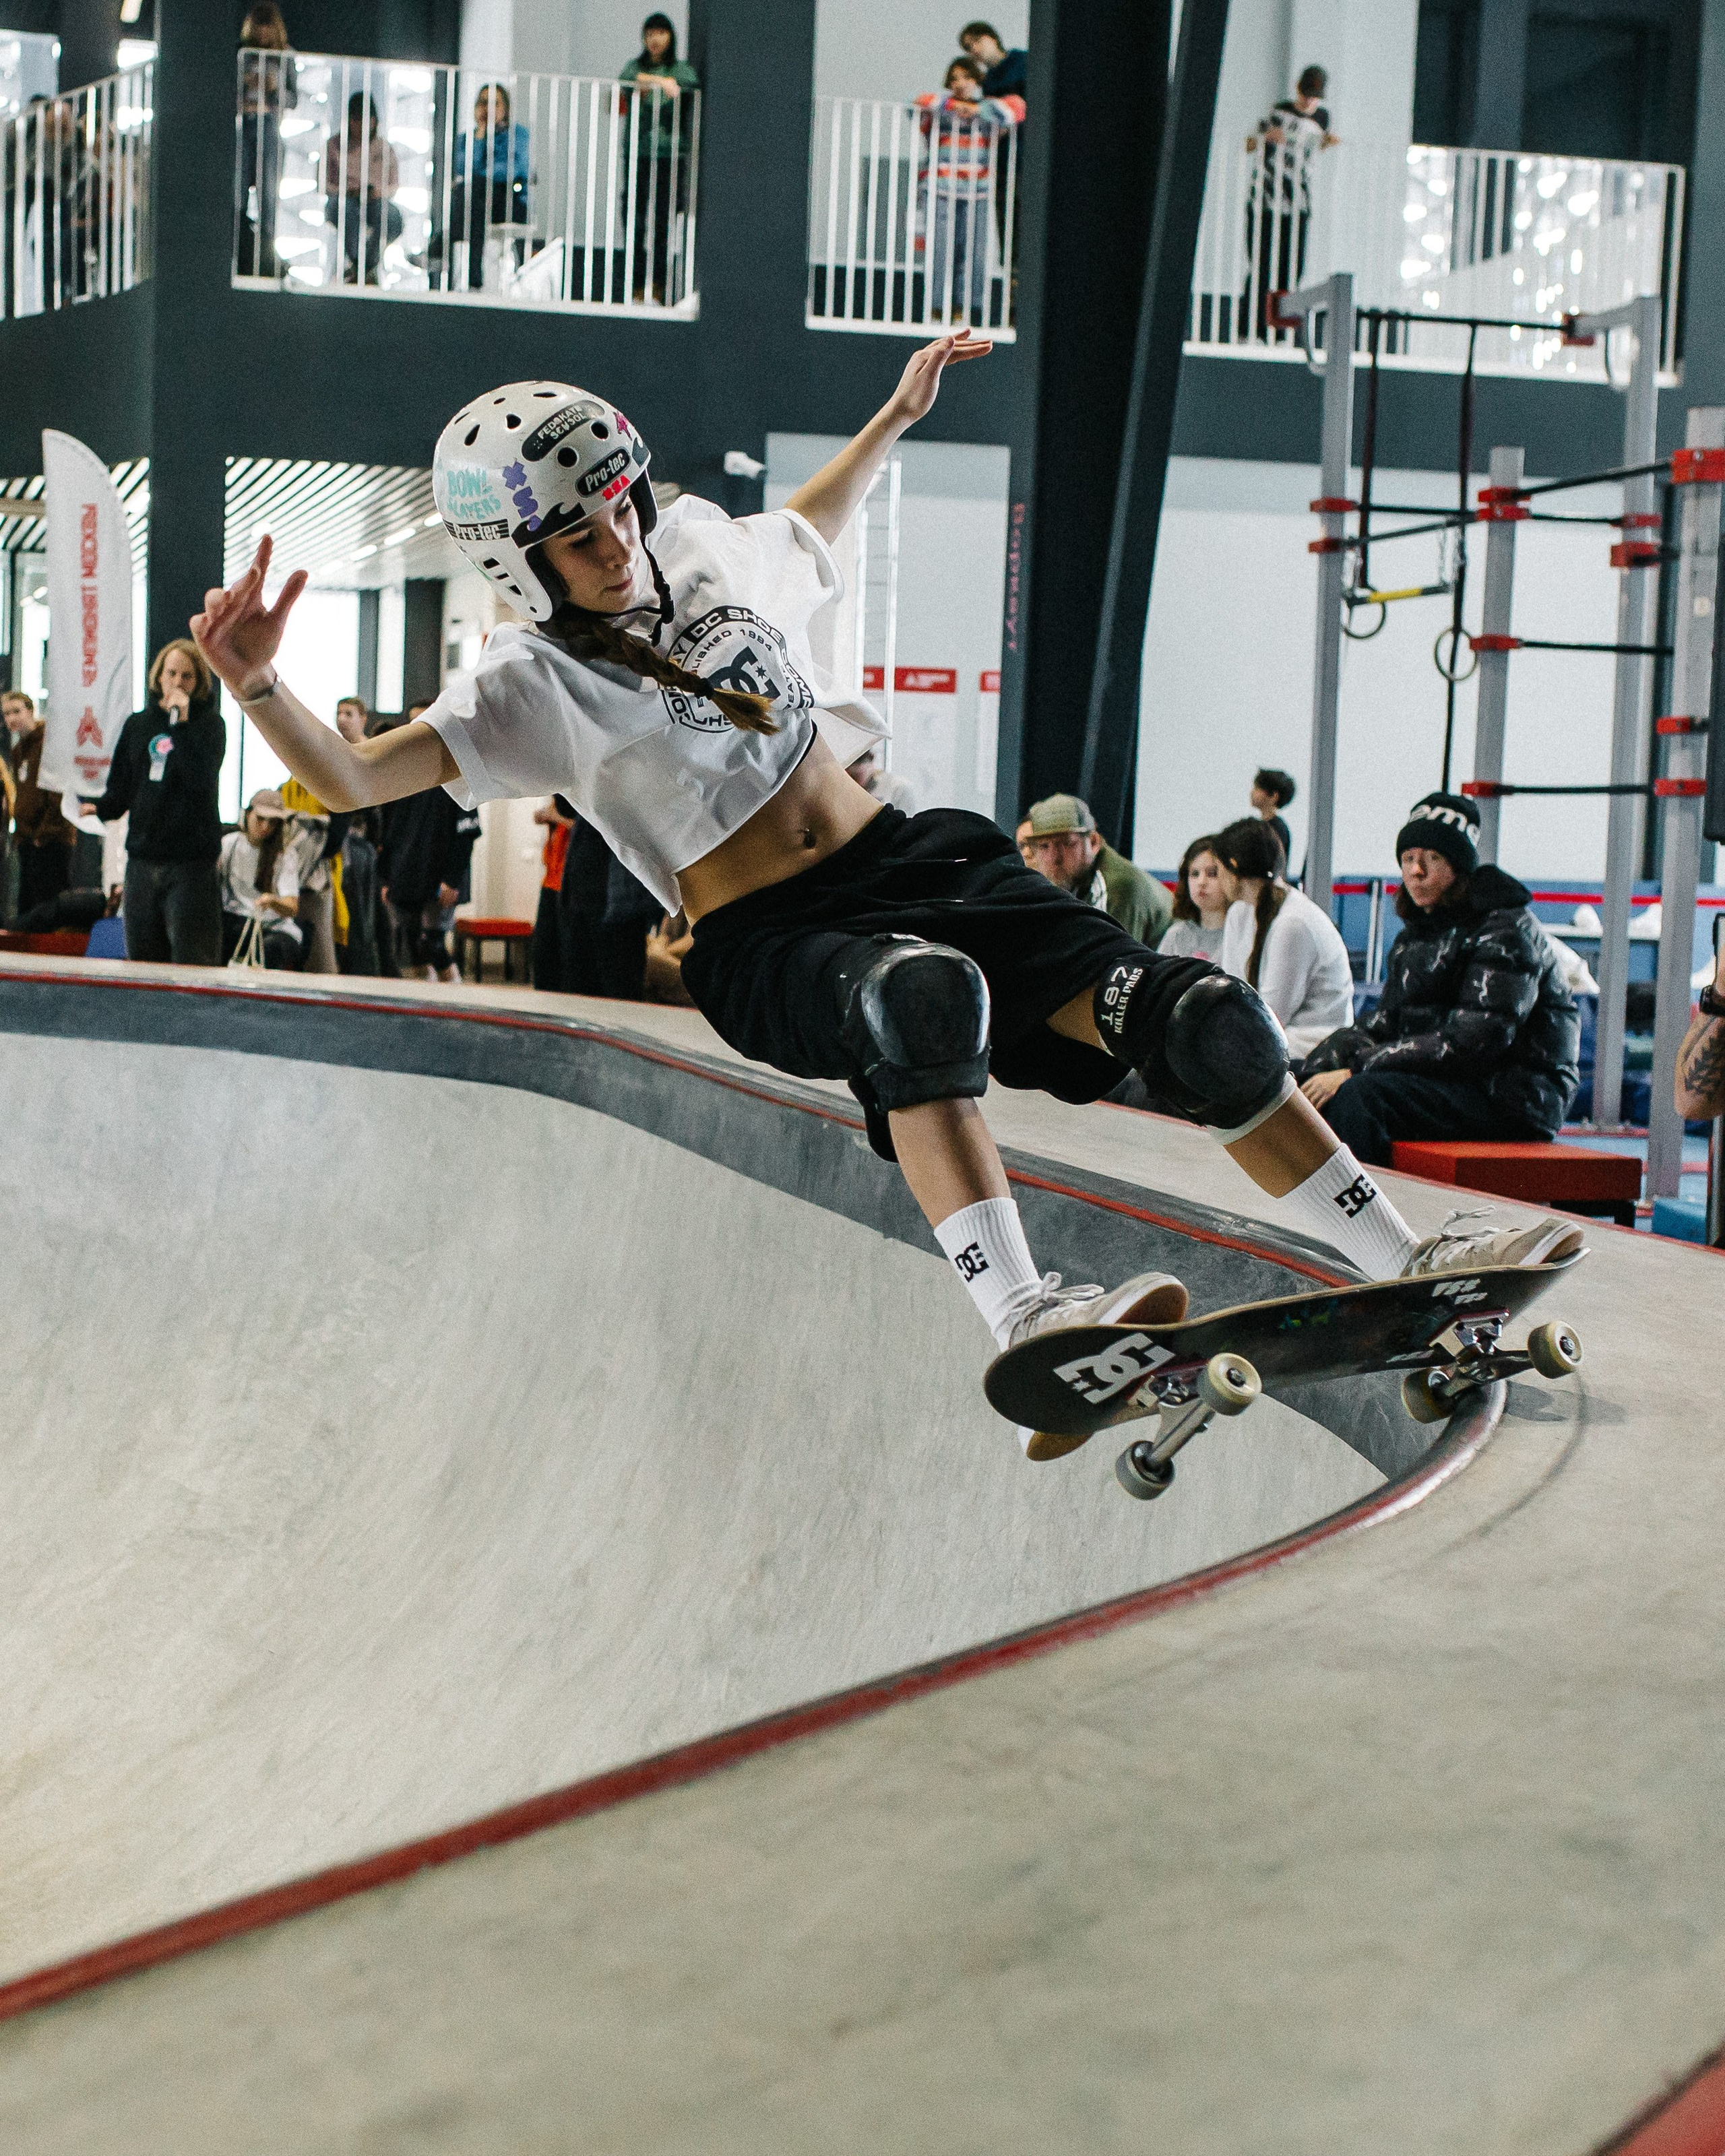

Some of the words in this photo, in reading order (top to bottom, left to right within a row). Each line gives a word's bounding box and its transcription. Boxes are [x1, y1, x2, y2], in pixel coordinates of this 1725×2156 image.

[447, 469, 493, 498] BOWL
[585, 453, 625, 493] Pro-tec
[452, 521, 501, 541] Pro-tec
[691, 612, 722, 639] DC
[739, 629, 773, 652] 1994
[1100, 965, 1129, 1026] 187
[1113, 996, 1129, 1034] KILLER
[1122, 967, 1144, 994] PADS
